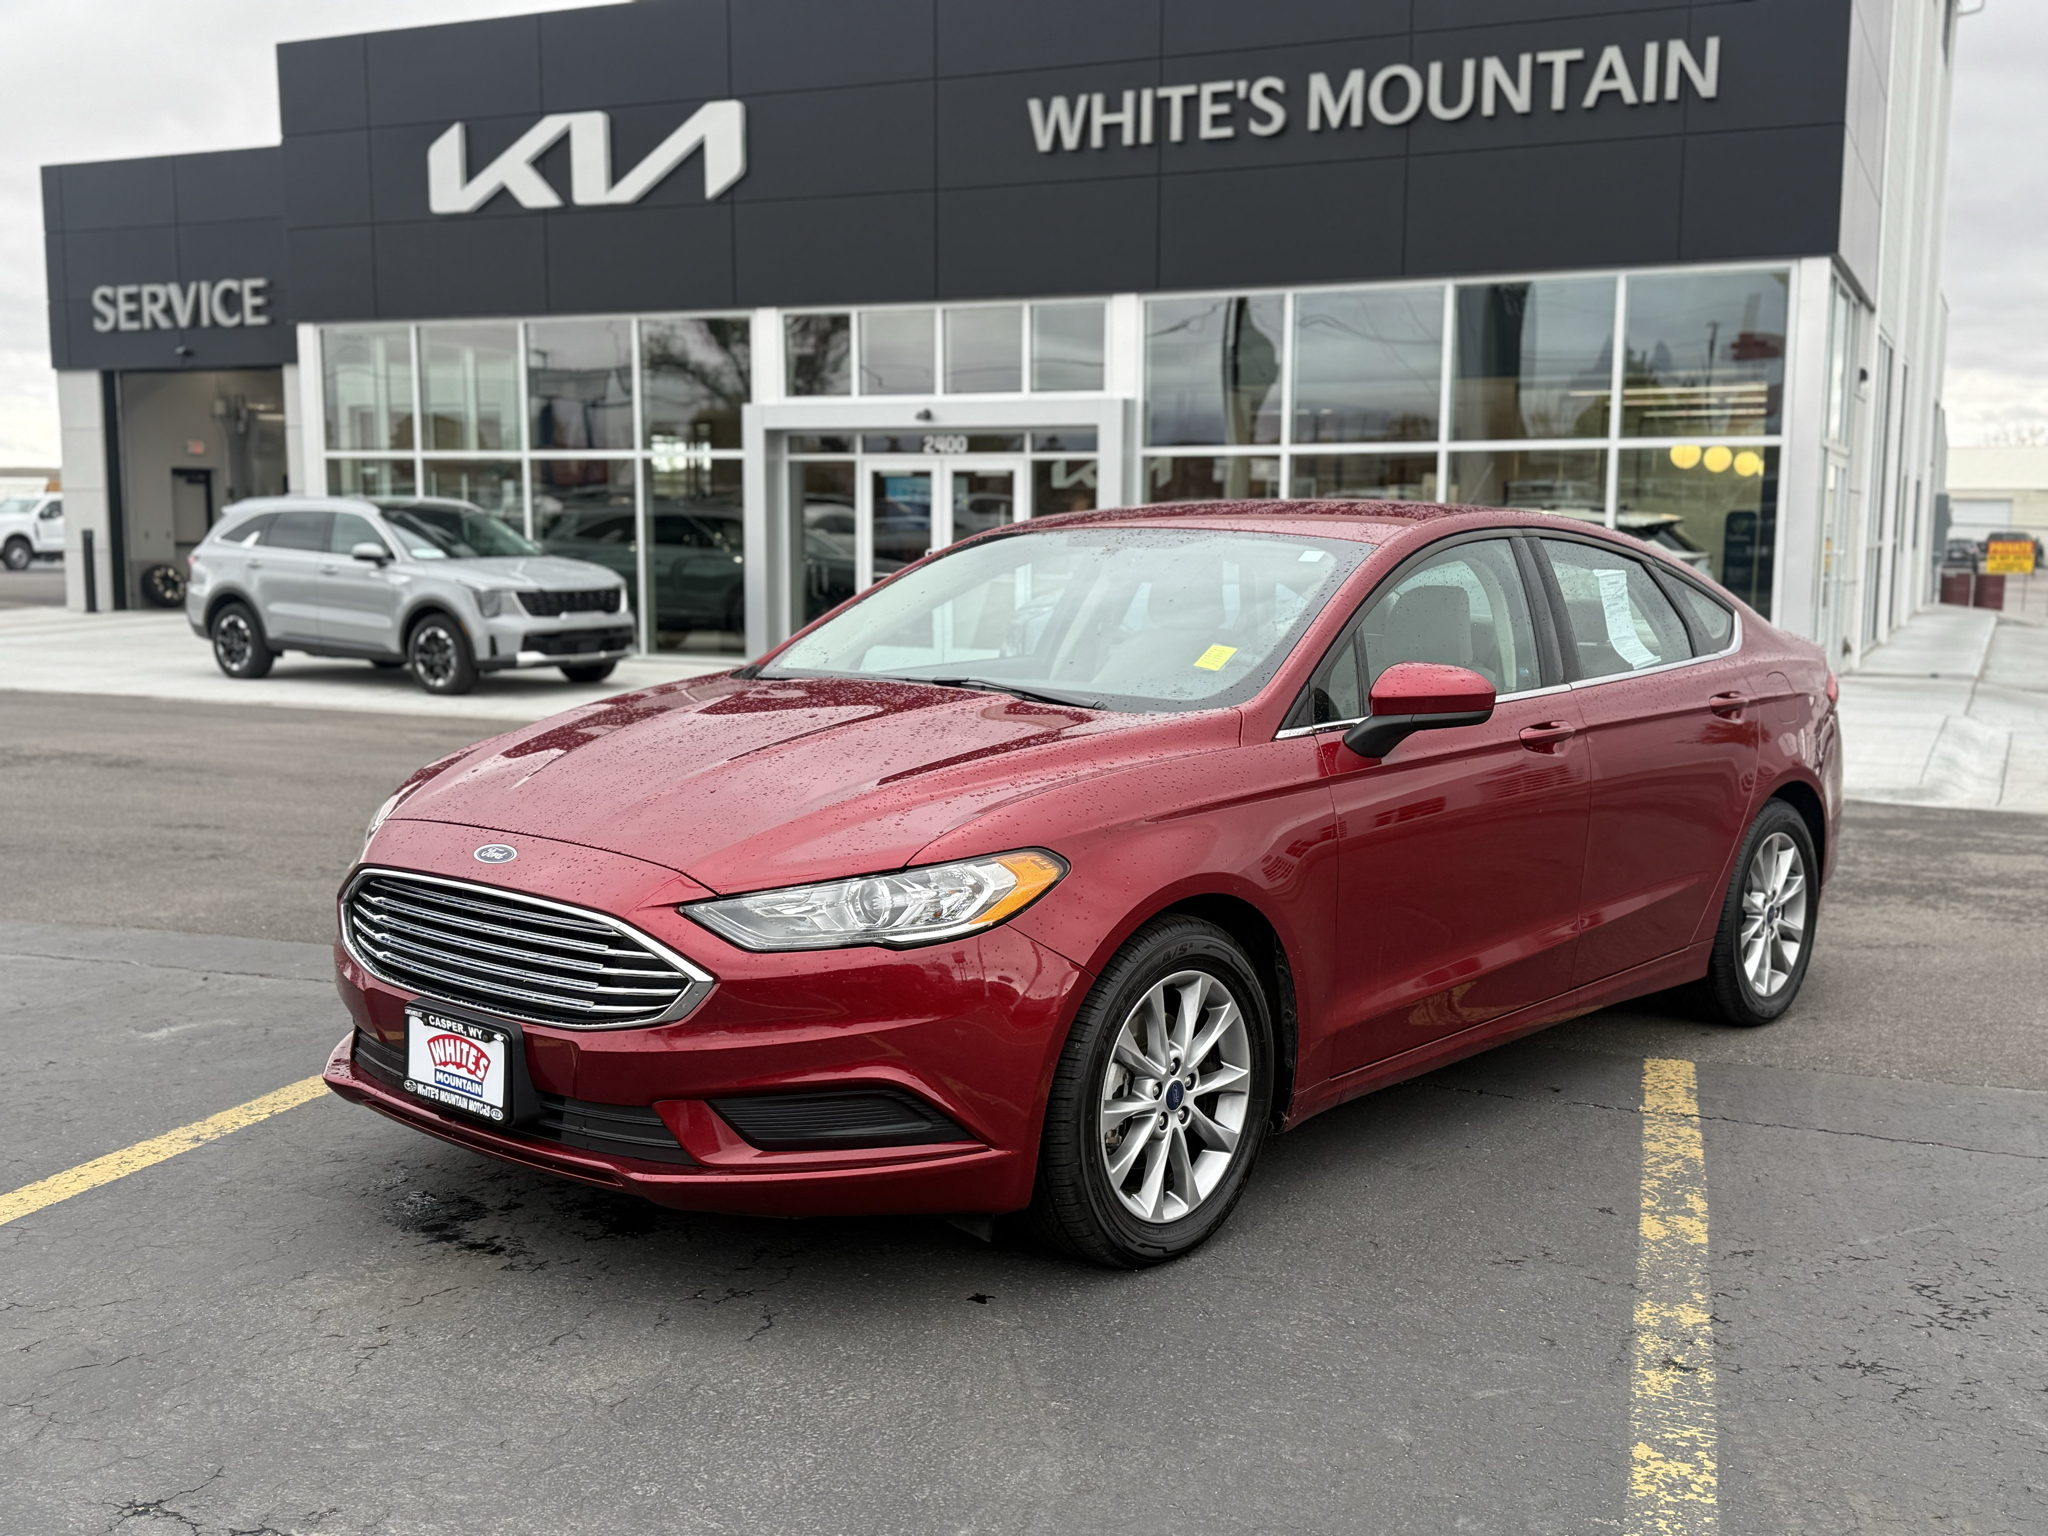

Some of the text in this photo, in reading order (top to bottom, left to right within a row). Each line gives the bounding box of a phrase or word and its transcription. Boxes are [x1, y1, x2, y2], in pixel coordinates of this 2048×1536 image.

[1028, 36, 1721, 153] WHITE'S MOUNTAIN
[92, 278, 270, 333] SERVICE
[922, 435, 968, 454] 2400
[428, 1015, 483, 1040] CASPER, WY
[430, 1037, 488, 1079] WHITE'S
[417, 1083, 439, 1099] WHITE'S
[439, 1090, 468, 1110] MOUNTAIN
[435, 1071, 482, 1095] MOUNTAIN
